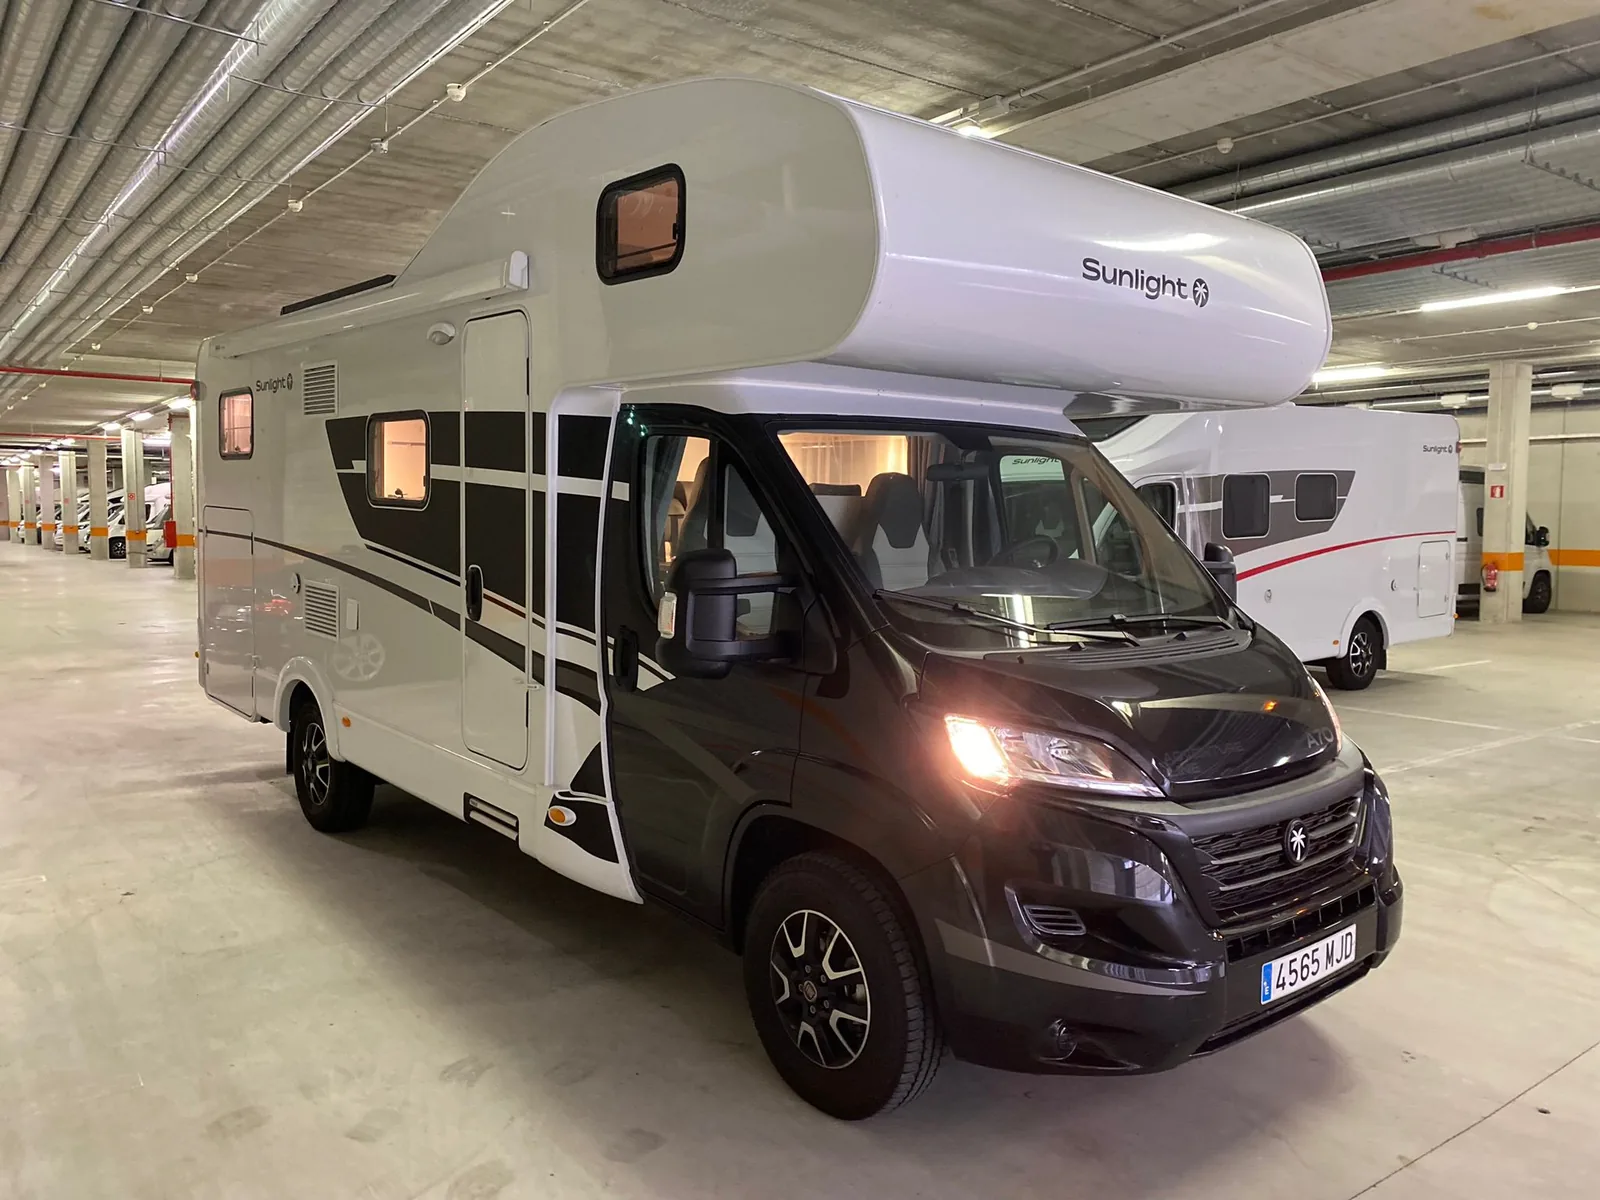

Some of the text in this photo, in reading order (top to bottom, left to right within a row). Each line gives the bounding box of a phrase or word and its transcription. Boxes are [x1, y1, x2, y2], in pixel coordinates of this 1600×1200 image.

[1082, 257, 1188, 300] Sunlight
[255, 377, 286, 393] Sunlight
[1422, 444, 1448, 455] Sunlight
[1306, 726, 1335, 748] A70
[1276, 931, 1353, 990] 4565 MJD
